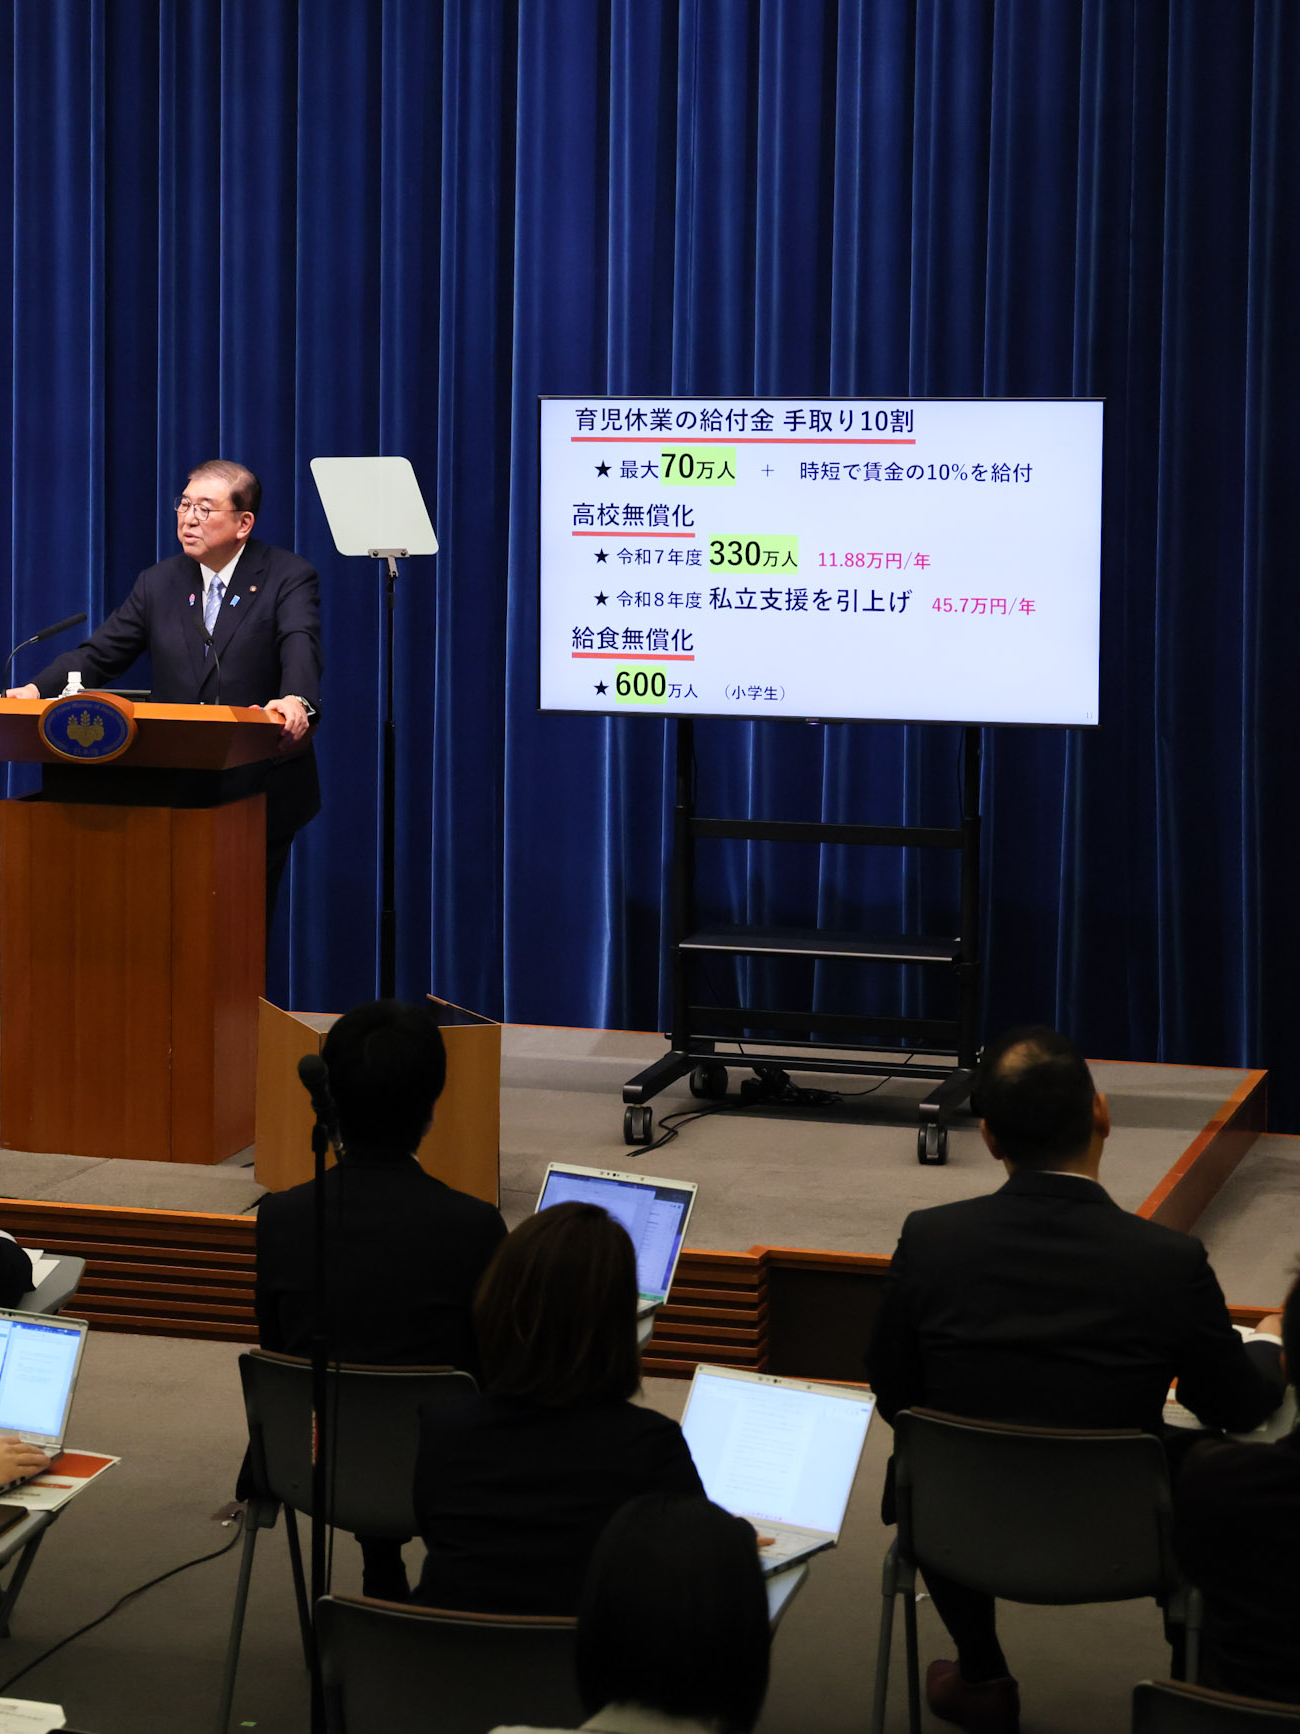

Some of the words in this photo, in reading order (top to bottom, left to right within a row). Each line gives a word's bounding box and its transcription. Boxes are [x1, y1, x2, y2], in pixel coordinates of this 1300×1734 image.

[575, 407, 774, 432] 育児休業の給付金
[784, 408, 914, 433] 手取り10割
[800, 461, 1034, 483] 時短で賃金の10%を給付
[572, 503, 694, 527] 高校無償化
[710, 540, 798, 568] 330万人
[818, 551, 930, 571] 11.88万円/年
[709, 586, 913, 614] 私立支援を引上げ
[931, 597, 1037, 616] 45.7万円/年
[572, 626, 693, 652] 給食無償化
[616, 671, 699, 698] 600万人
